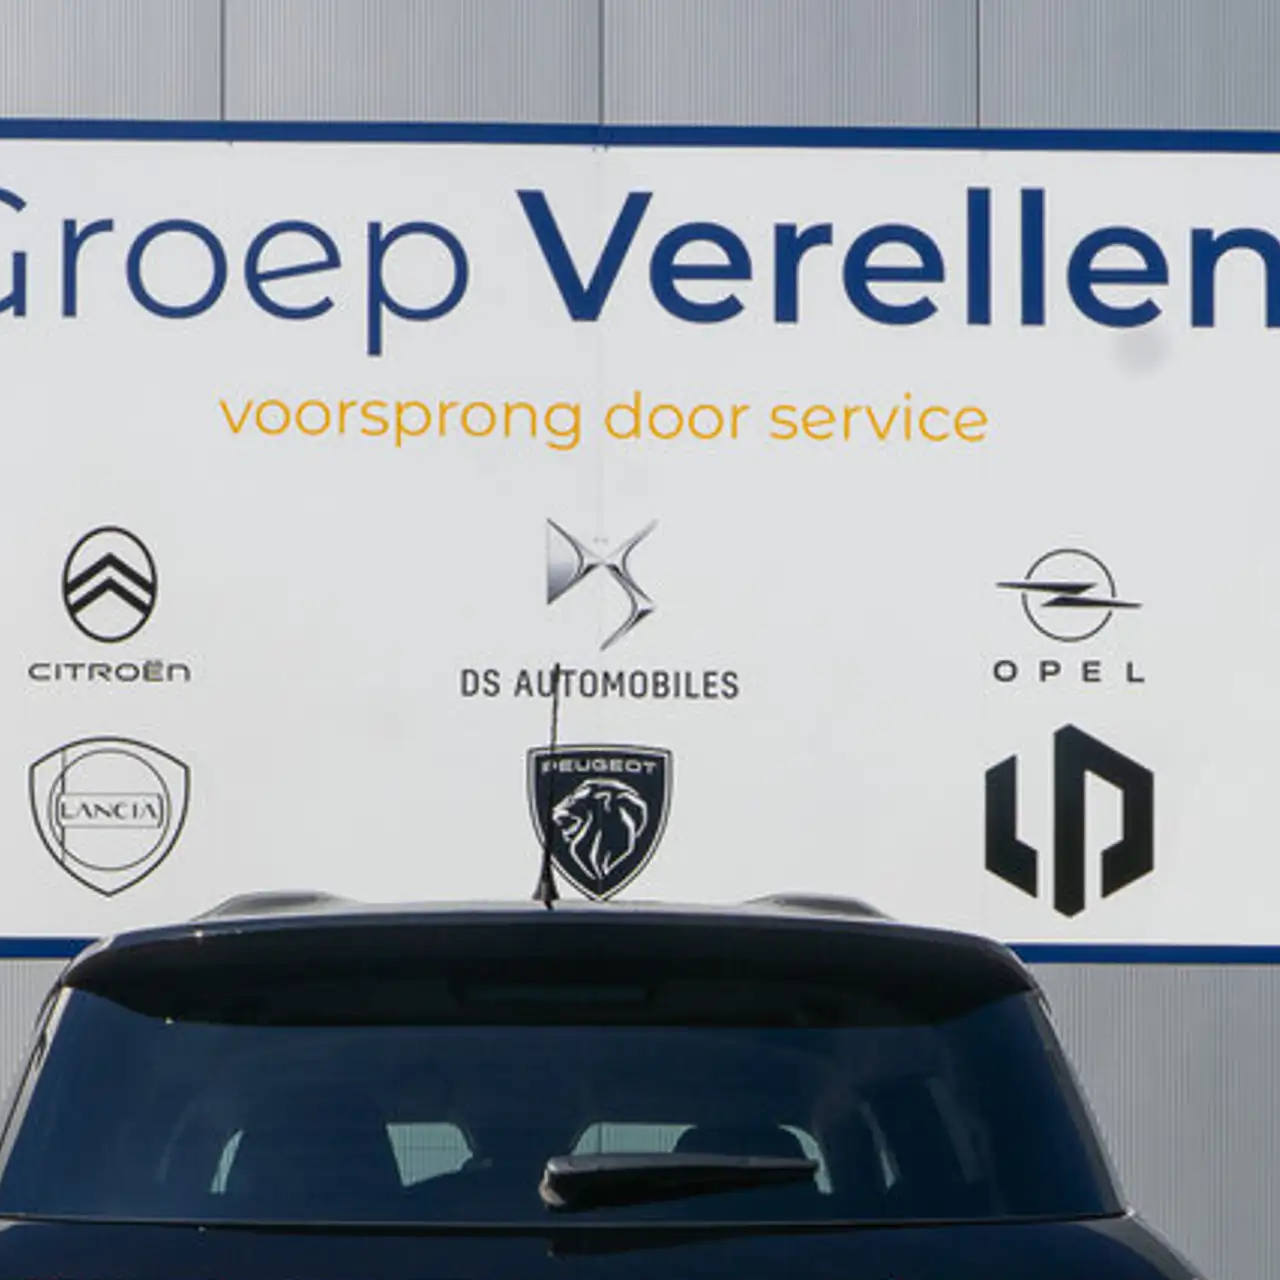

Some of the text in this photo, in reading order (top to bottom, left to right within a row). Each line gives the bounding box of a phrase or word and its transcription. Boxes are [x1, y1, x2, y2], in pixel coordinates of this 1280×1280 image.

[218, 390, 990, 452] voorsprong door service
[460, 667, 740, 700] DS AUTOMOBILES
[992, 659, 1146, 684] OPEL
[60, 800, 158, 820] LANCIA
